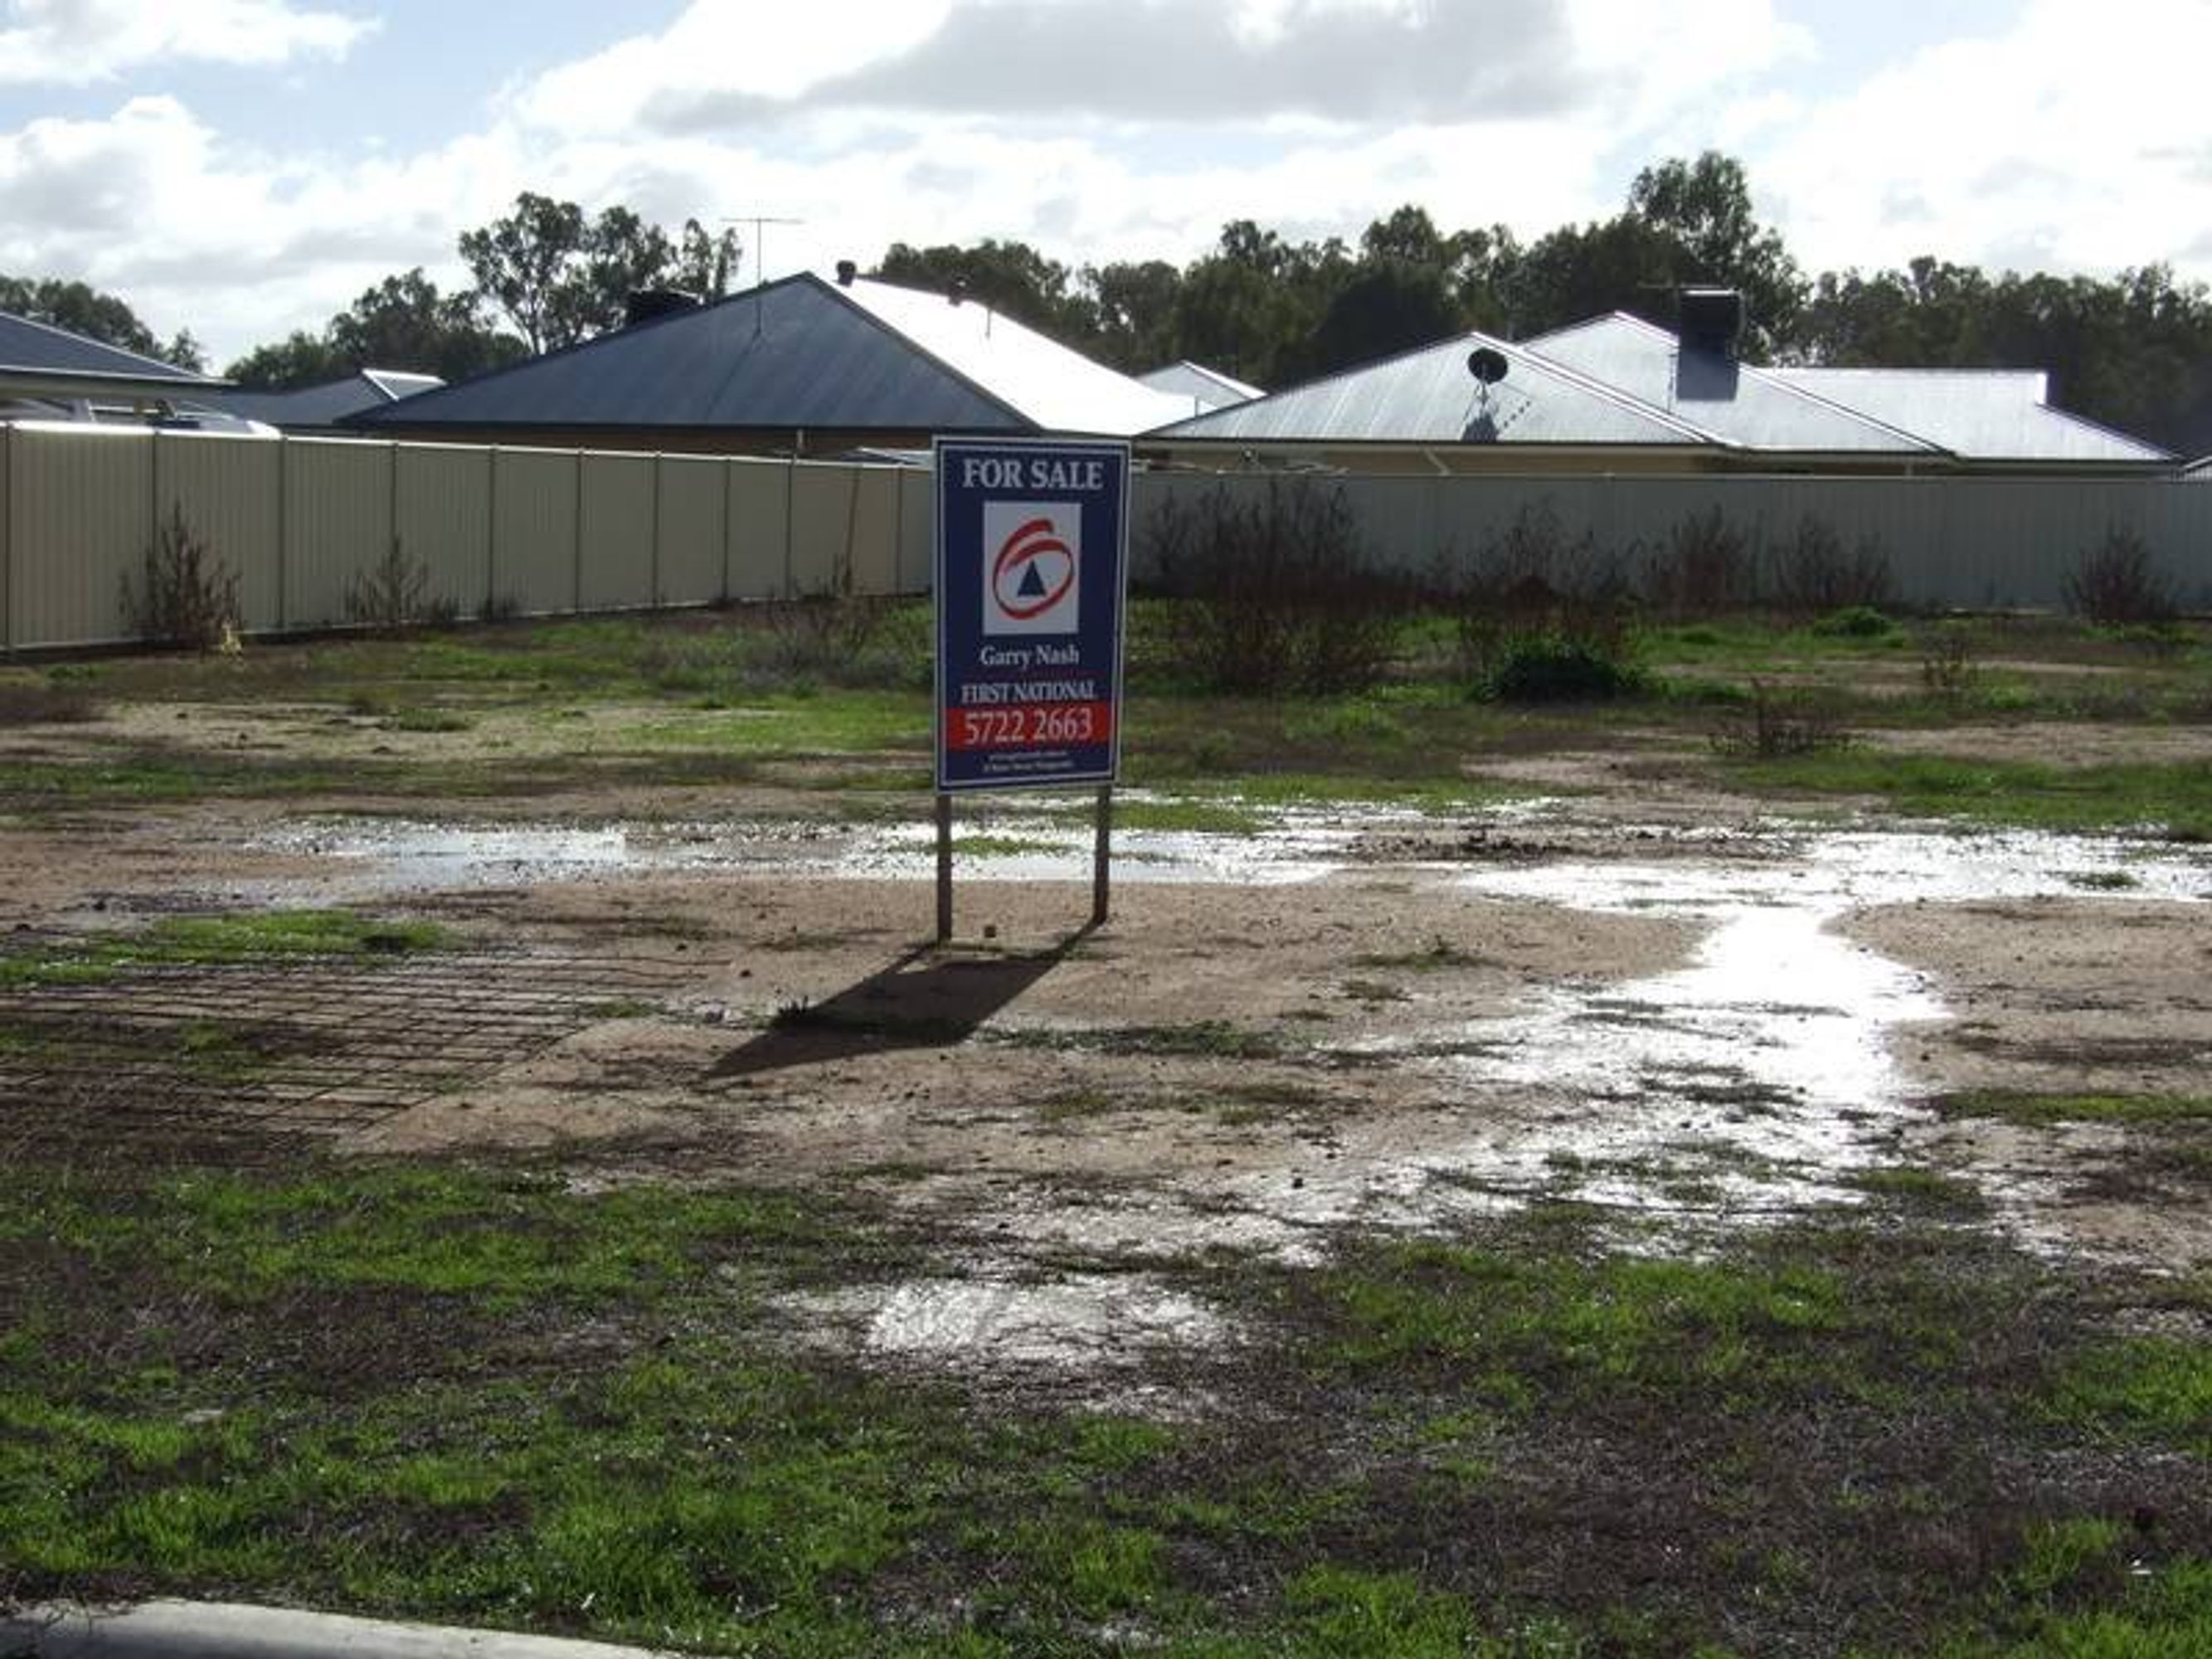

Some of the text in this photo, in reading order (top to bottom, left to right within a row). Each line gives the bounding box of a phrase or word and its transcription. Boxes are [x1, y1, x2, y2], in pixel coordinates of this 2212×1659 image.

[962, 458, 1104, 489] FOR SALE
[980, 645, 1080, 670] Garry Nash
[961, 679, 1096, 703] FIRST NATIONAL
[965, 707, 1093, 744] 5722 2663
